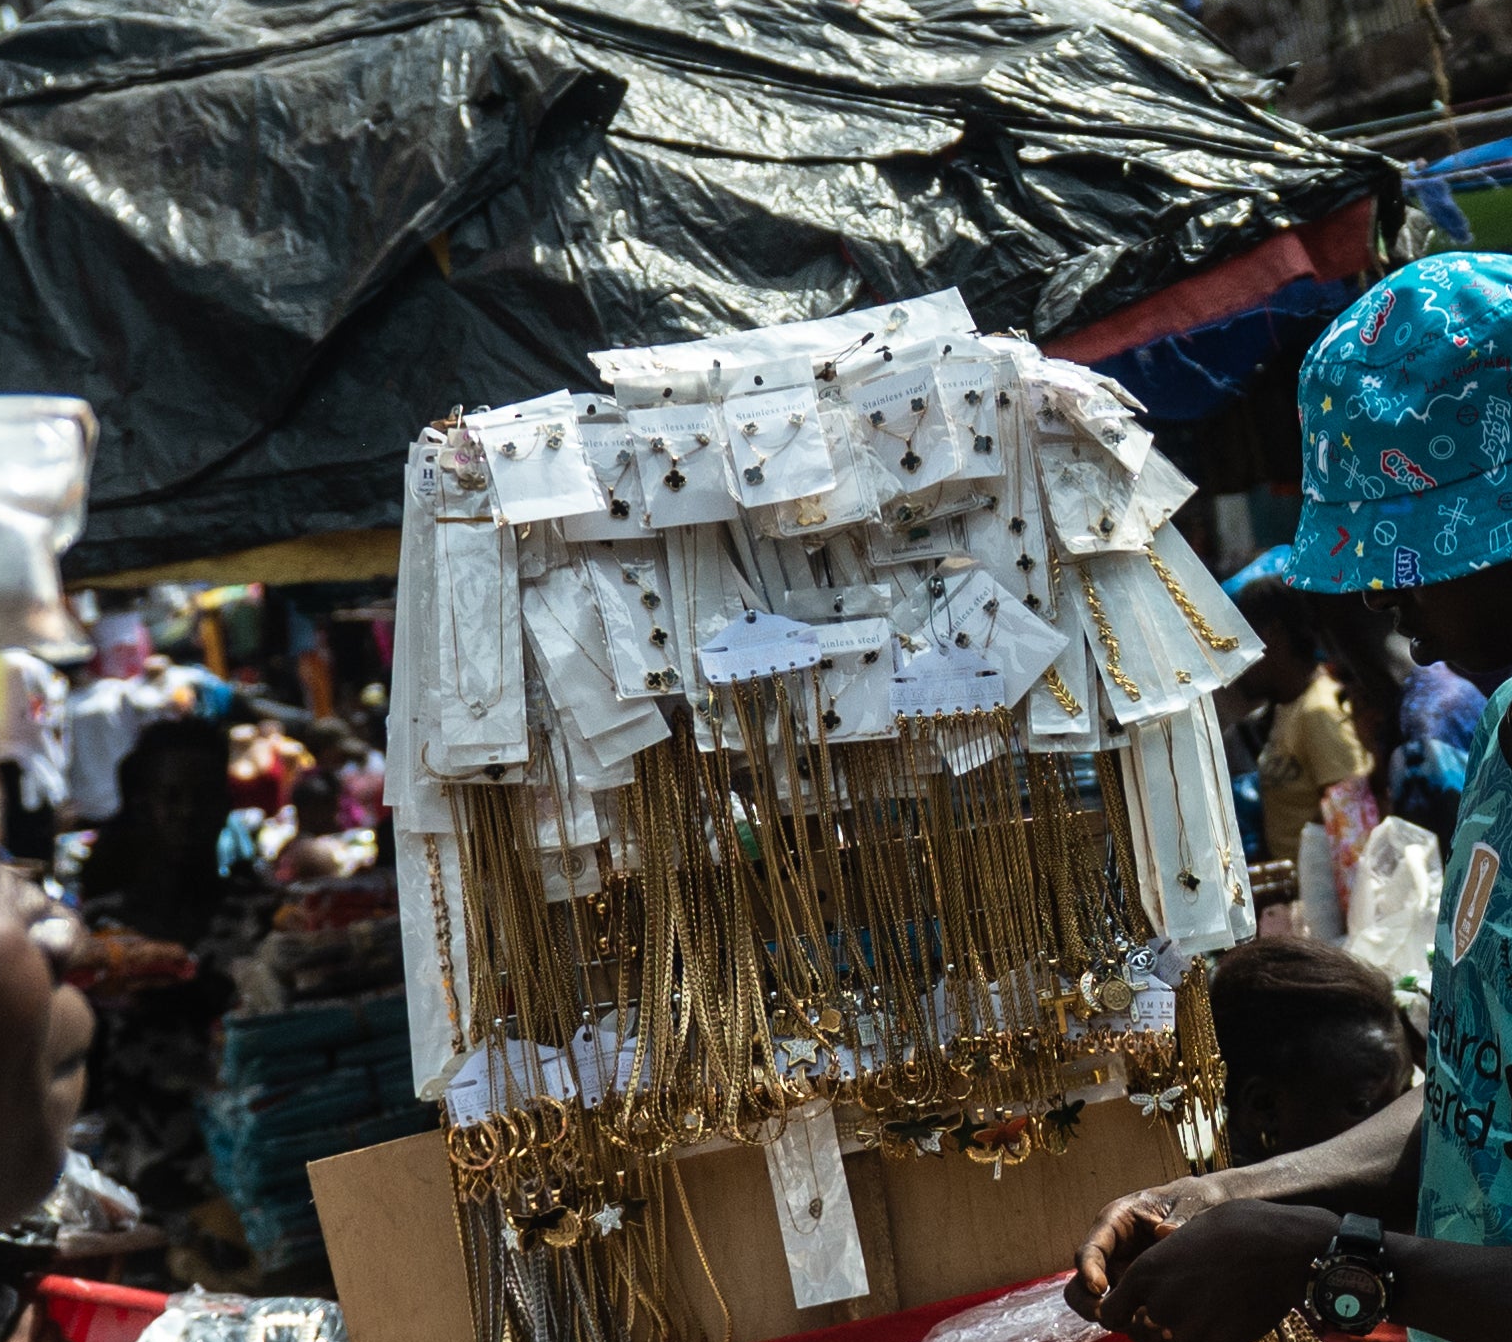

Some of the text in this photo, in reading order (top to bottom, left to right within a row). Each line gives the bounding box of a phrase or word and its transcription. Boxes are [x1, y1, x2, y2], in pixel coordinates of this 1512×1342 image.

[861, 381, 928, 411] Stainless steel
[735, 405, 781, 421] Stainless
[640, 419, 711, 435] Stainless steel
[857, 634, 882, 648] steel
